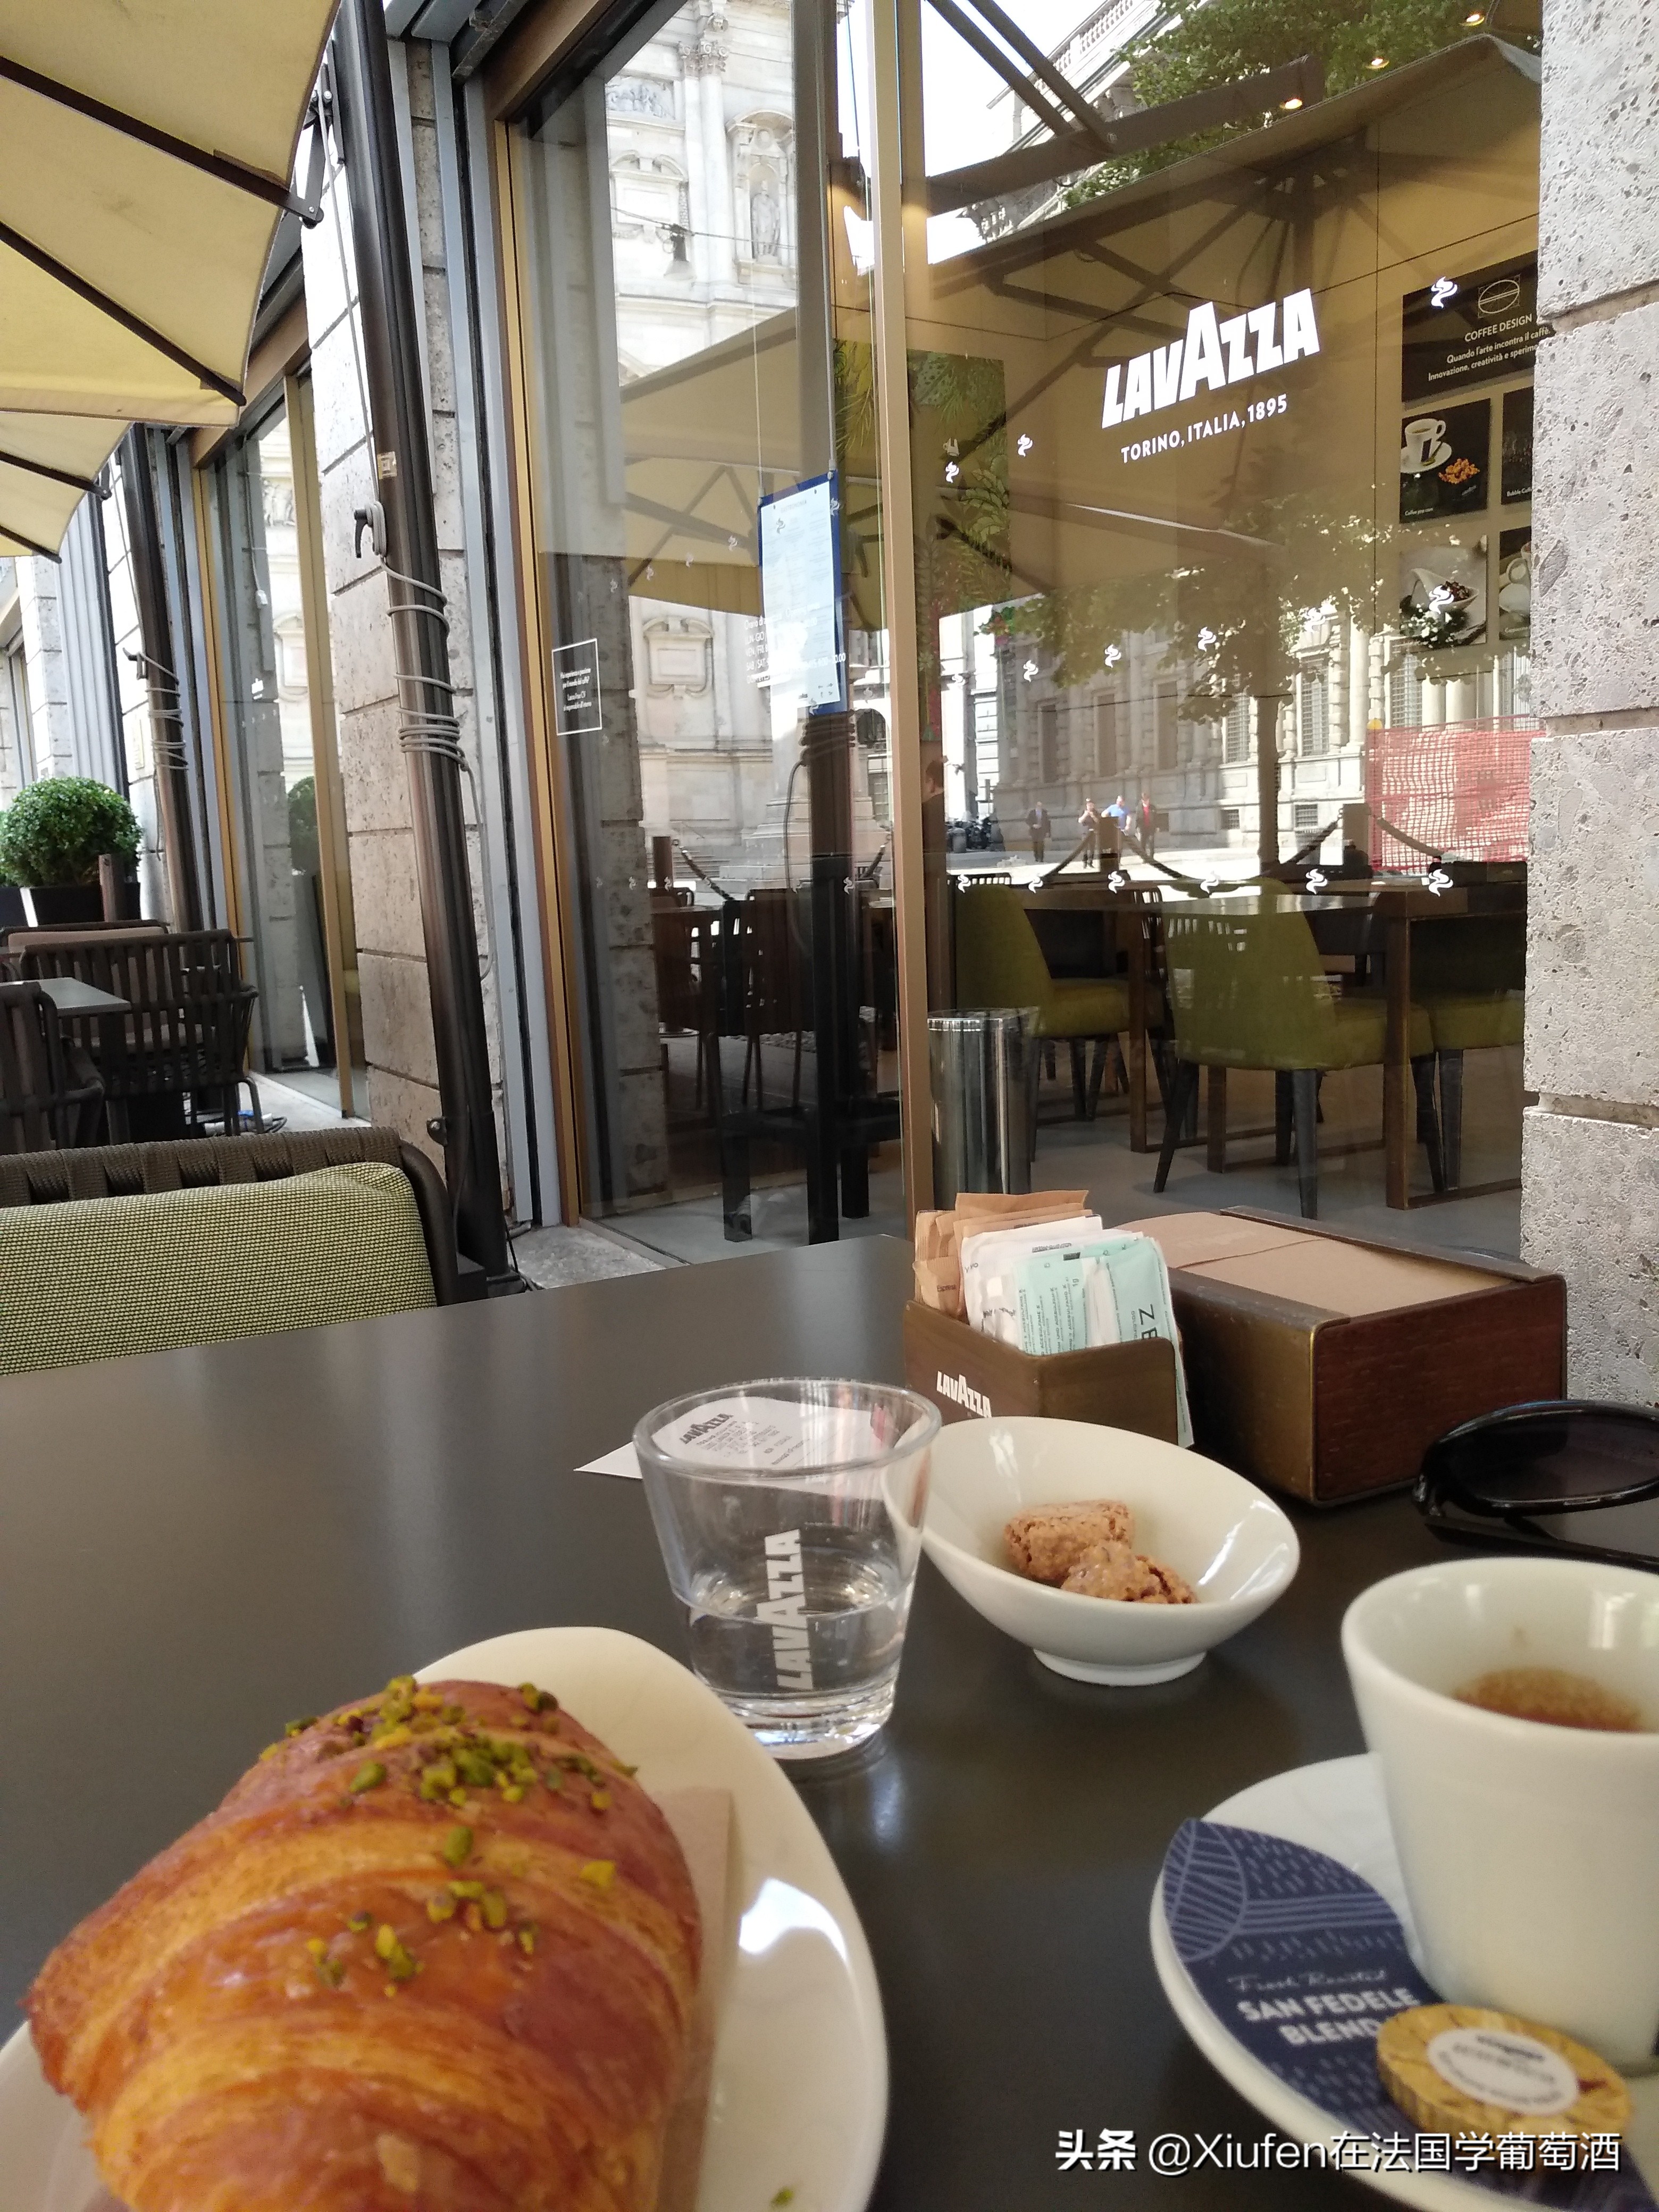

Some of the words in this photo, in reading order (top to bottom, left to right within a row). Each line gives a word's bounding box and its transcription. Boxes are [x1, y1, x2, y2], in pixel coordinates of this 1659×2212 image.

[1464, 324, 1497, 342] COFFEE
[1499, 313, 1532, 331] DESIGN
[1102, 288, 1320, 429] LAVAZZA
[1447, 349, 1474, 364] Quando
[1494, 336, 1523, 350] incontra
[1524, 331, 1529, 341] il
[1471, 353, 1503, 369] creatività
[1121, 430, 1185, 464] TORINO,
[1187, 410, 1245, 442] ITALIA,
[1247, 393, 1287, 423] 1895
[937, 1370, 992, 1418] LAVAZZA
[756, 1528, 813, 1690] LAVAZZA
[1237, 1998, 1305, 2022] SAN
[1304, 1987, 1421, 2015] FEDELE
[1279, 2018, 1382, 2046] BLEND
